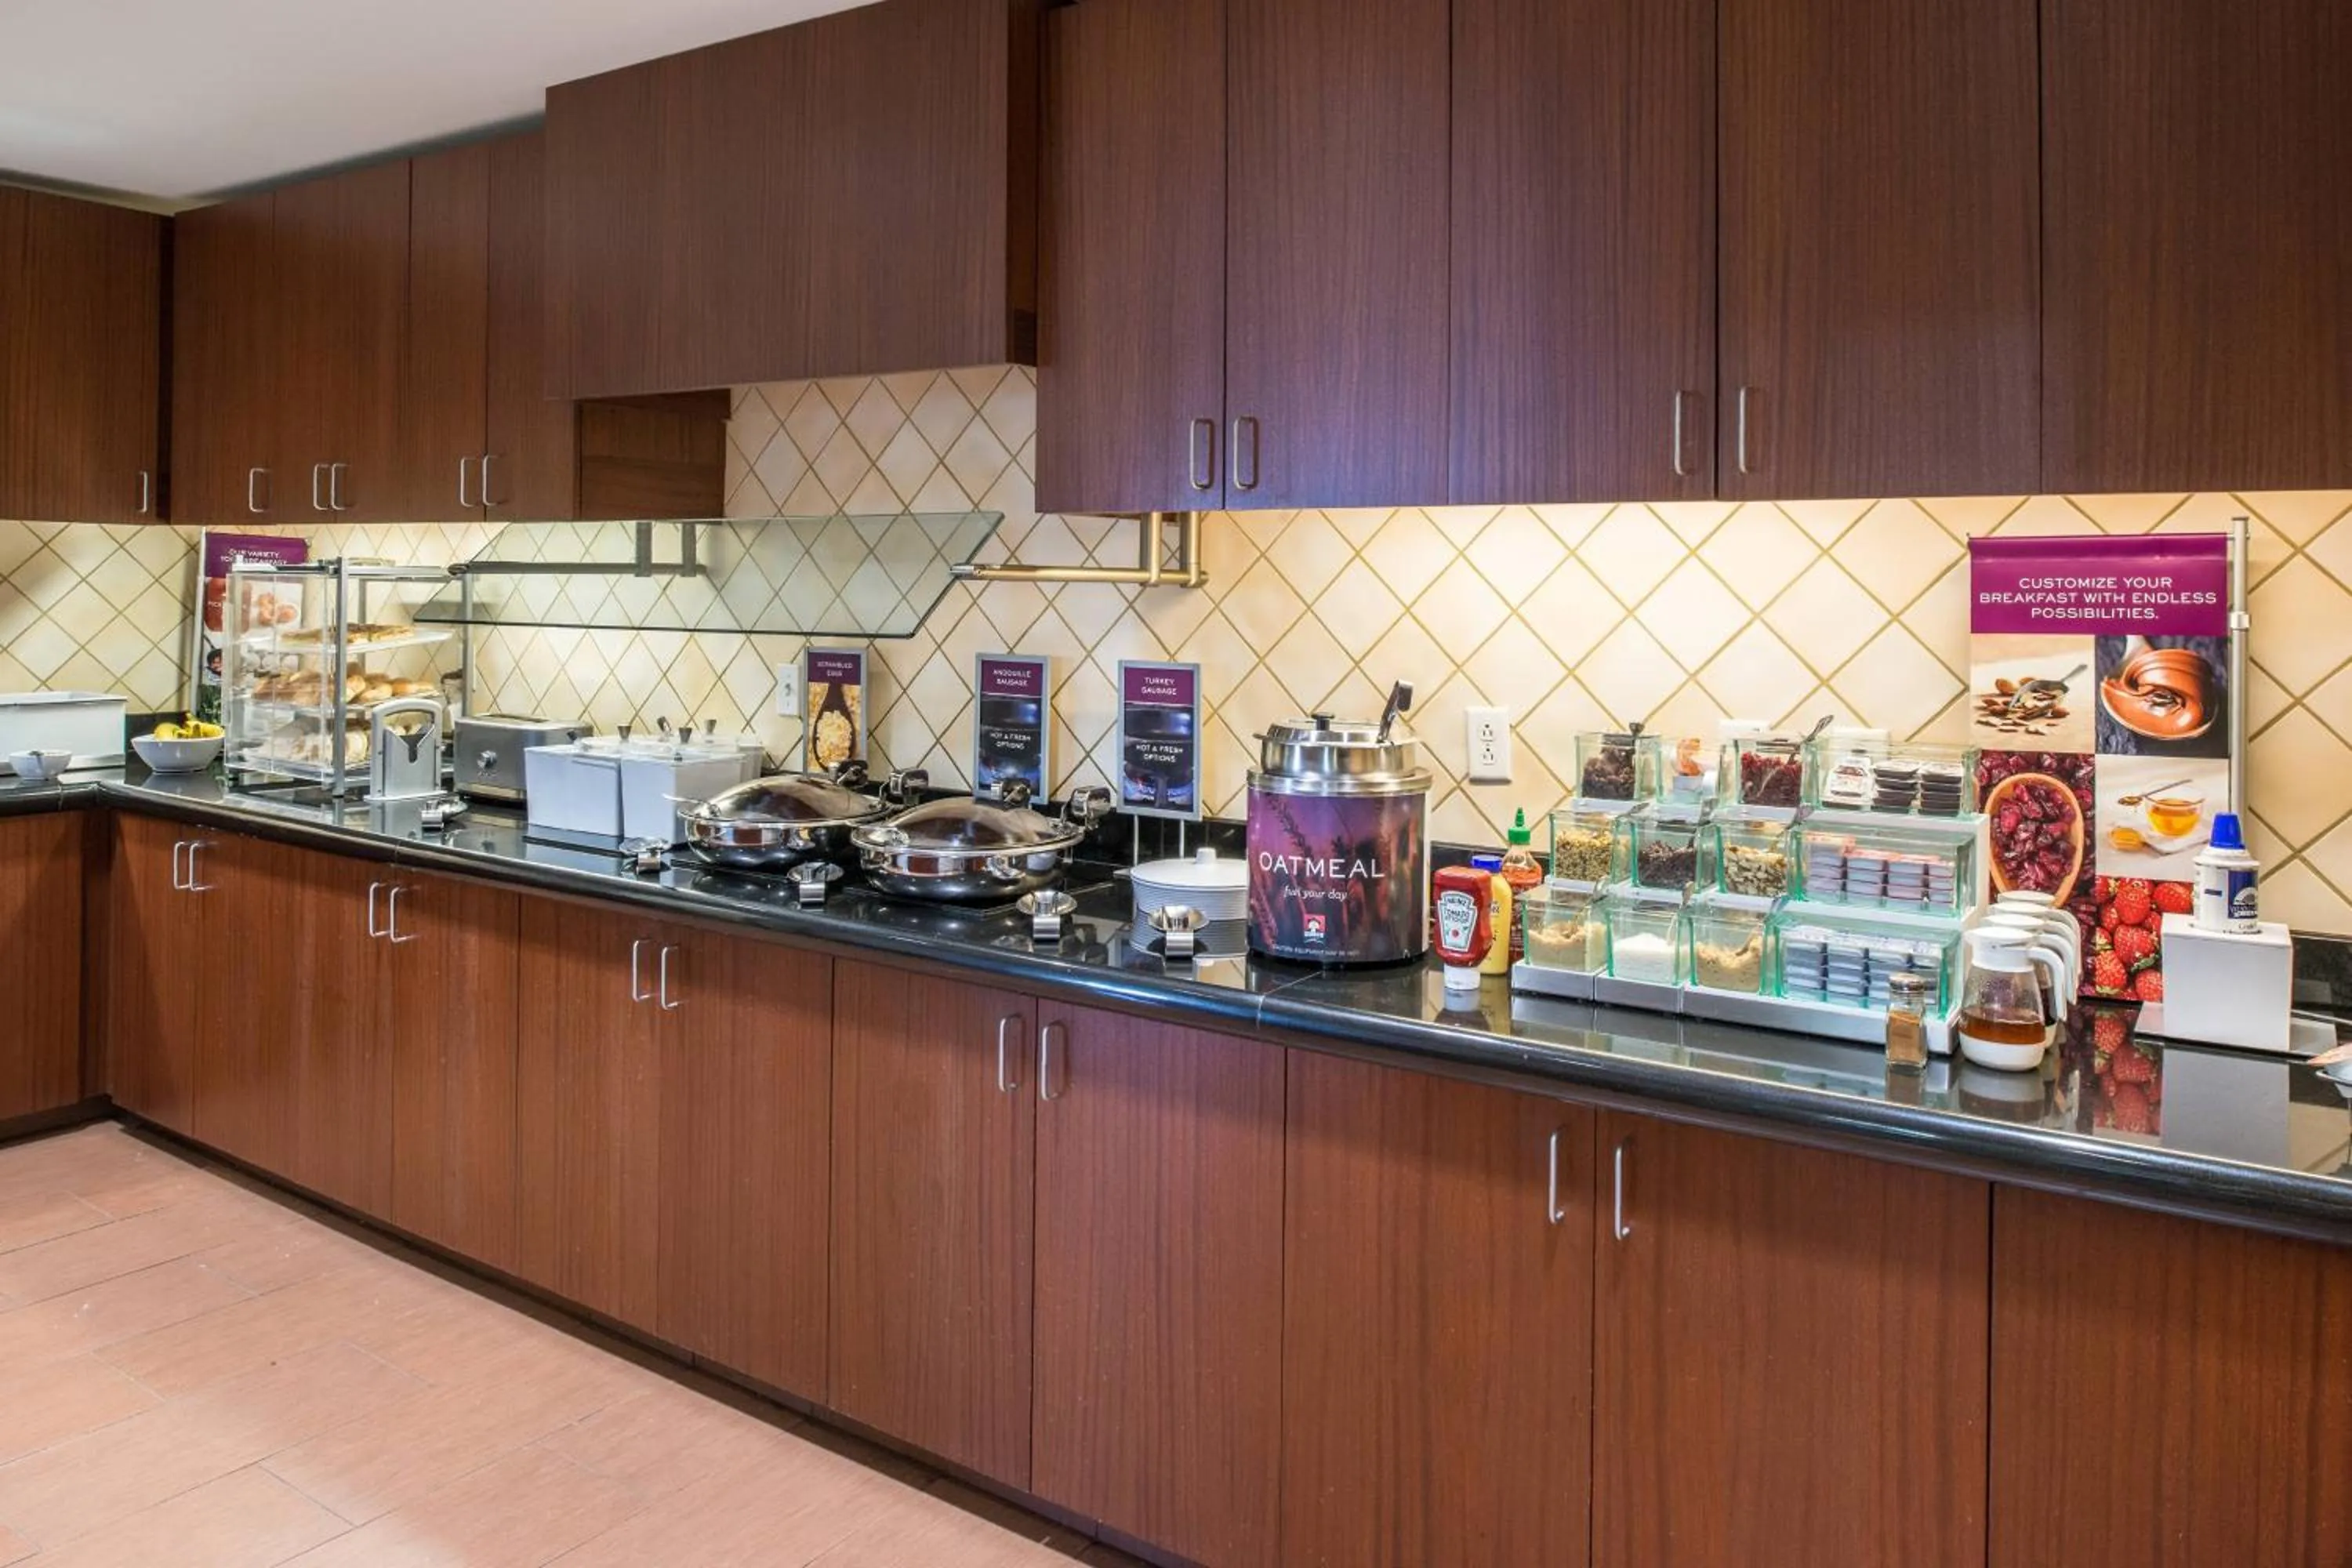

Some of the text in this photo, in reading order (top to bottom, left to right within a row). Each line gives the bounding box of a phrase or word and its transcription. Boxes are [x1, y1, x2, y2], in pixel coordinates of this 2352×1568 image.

[2019, 577, 2172, 589] CUSTOMIZE YOUR
[1980, 592, 2217, 604] BREAKFAST WITH ENDLESS
[2031, 608, 2159, 619] POSSIBILITIES.
[996, 678, 1029, 687] SAUSAGE
[1144, 677, 1175, 685] TURKEY
[1141, 686, 1178, 695] SAUSAGE
[996, 741, 1025, 750] OPTIONS
[1143, 753, 1177, 763] OPTIONS
[1259, 851, 1385, 878] OATMEAL
[1301, 890, 1325, 899] your
[1328, 888, 1348, 902] day
